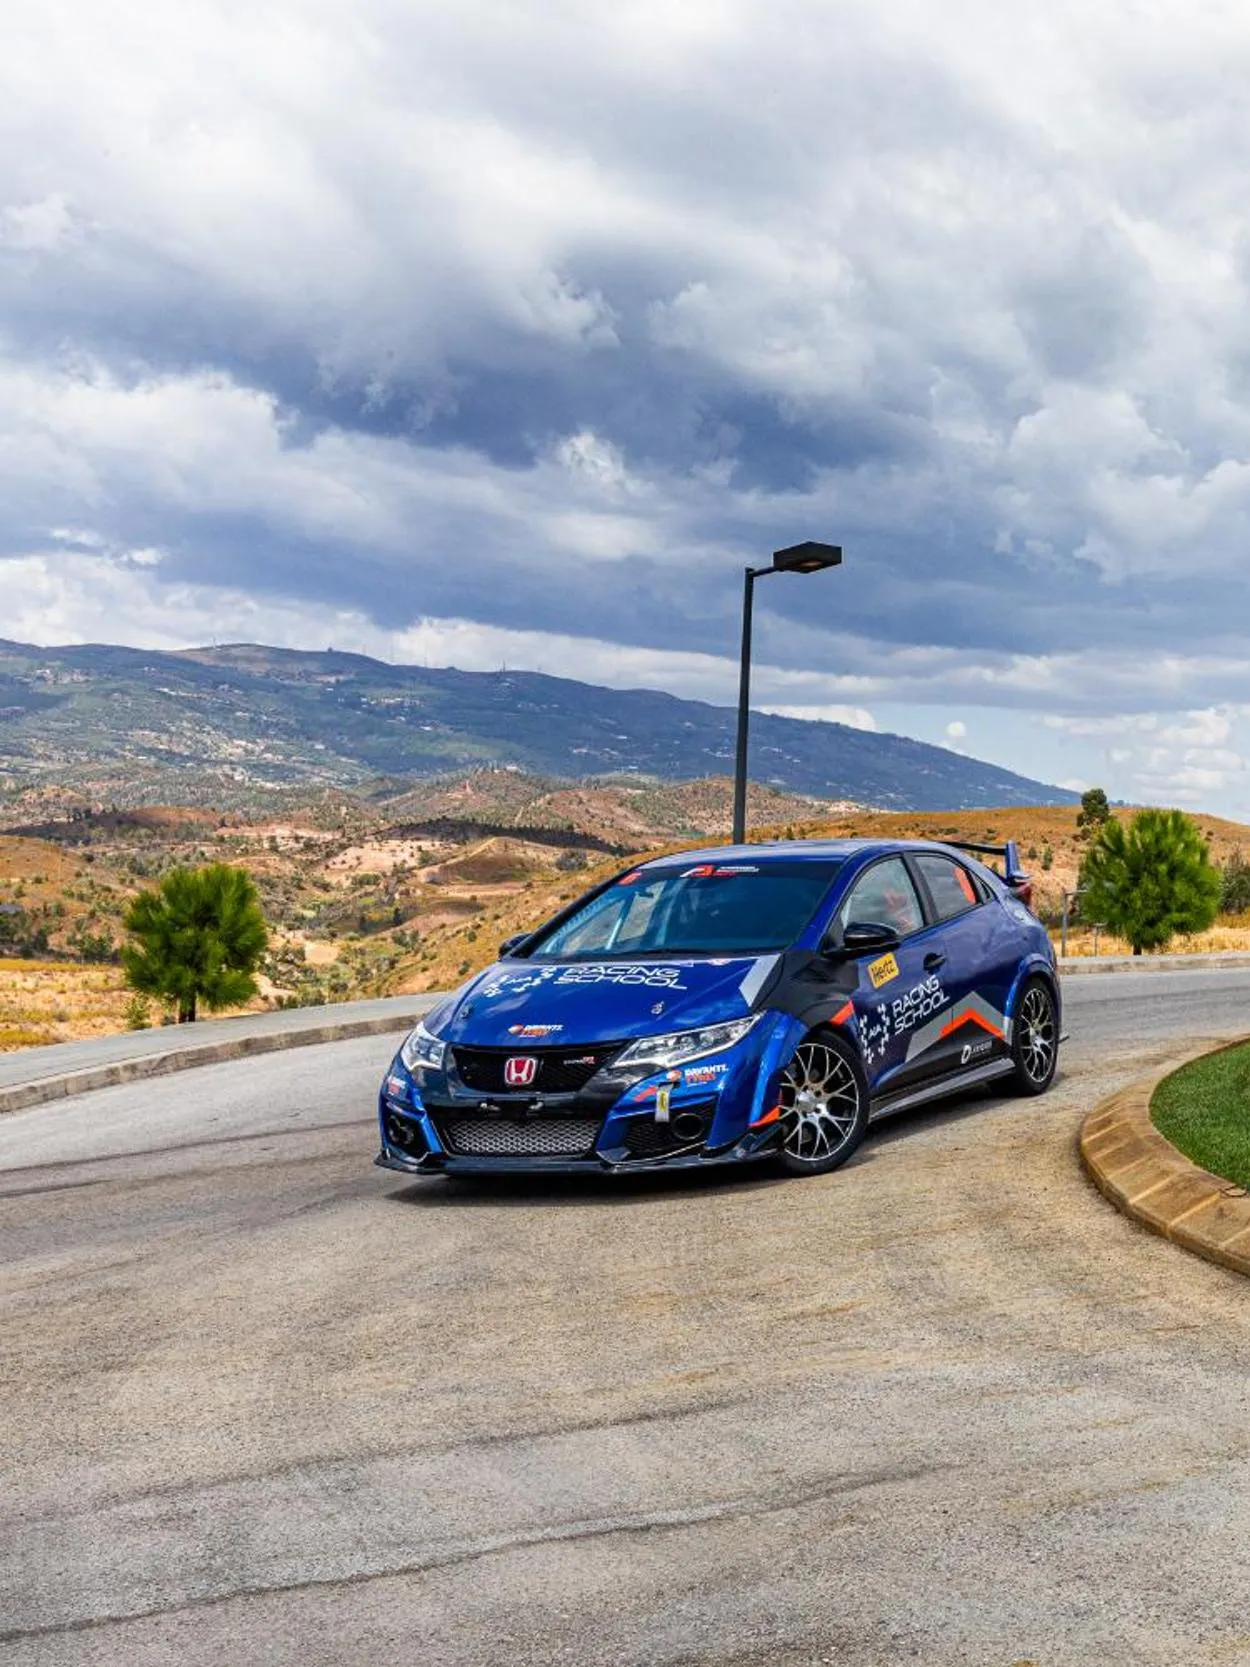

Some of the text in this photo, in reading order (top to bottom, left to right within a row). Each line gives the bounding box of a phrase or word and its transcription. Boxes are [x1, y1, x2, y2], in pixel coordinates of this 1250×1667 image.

[553, 975, 687, 990] SCHOOL
[563, 966, 681, 978] RACING
[892, 973, 940, 1018] RACING
[894, 988, 951, 1036] SCHOOL
